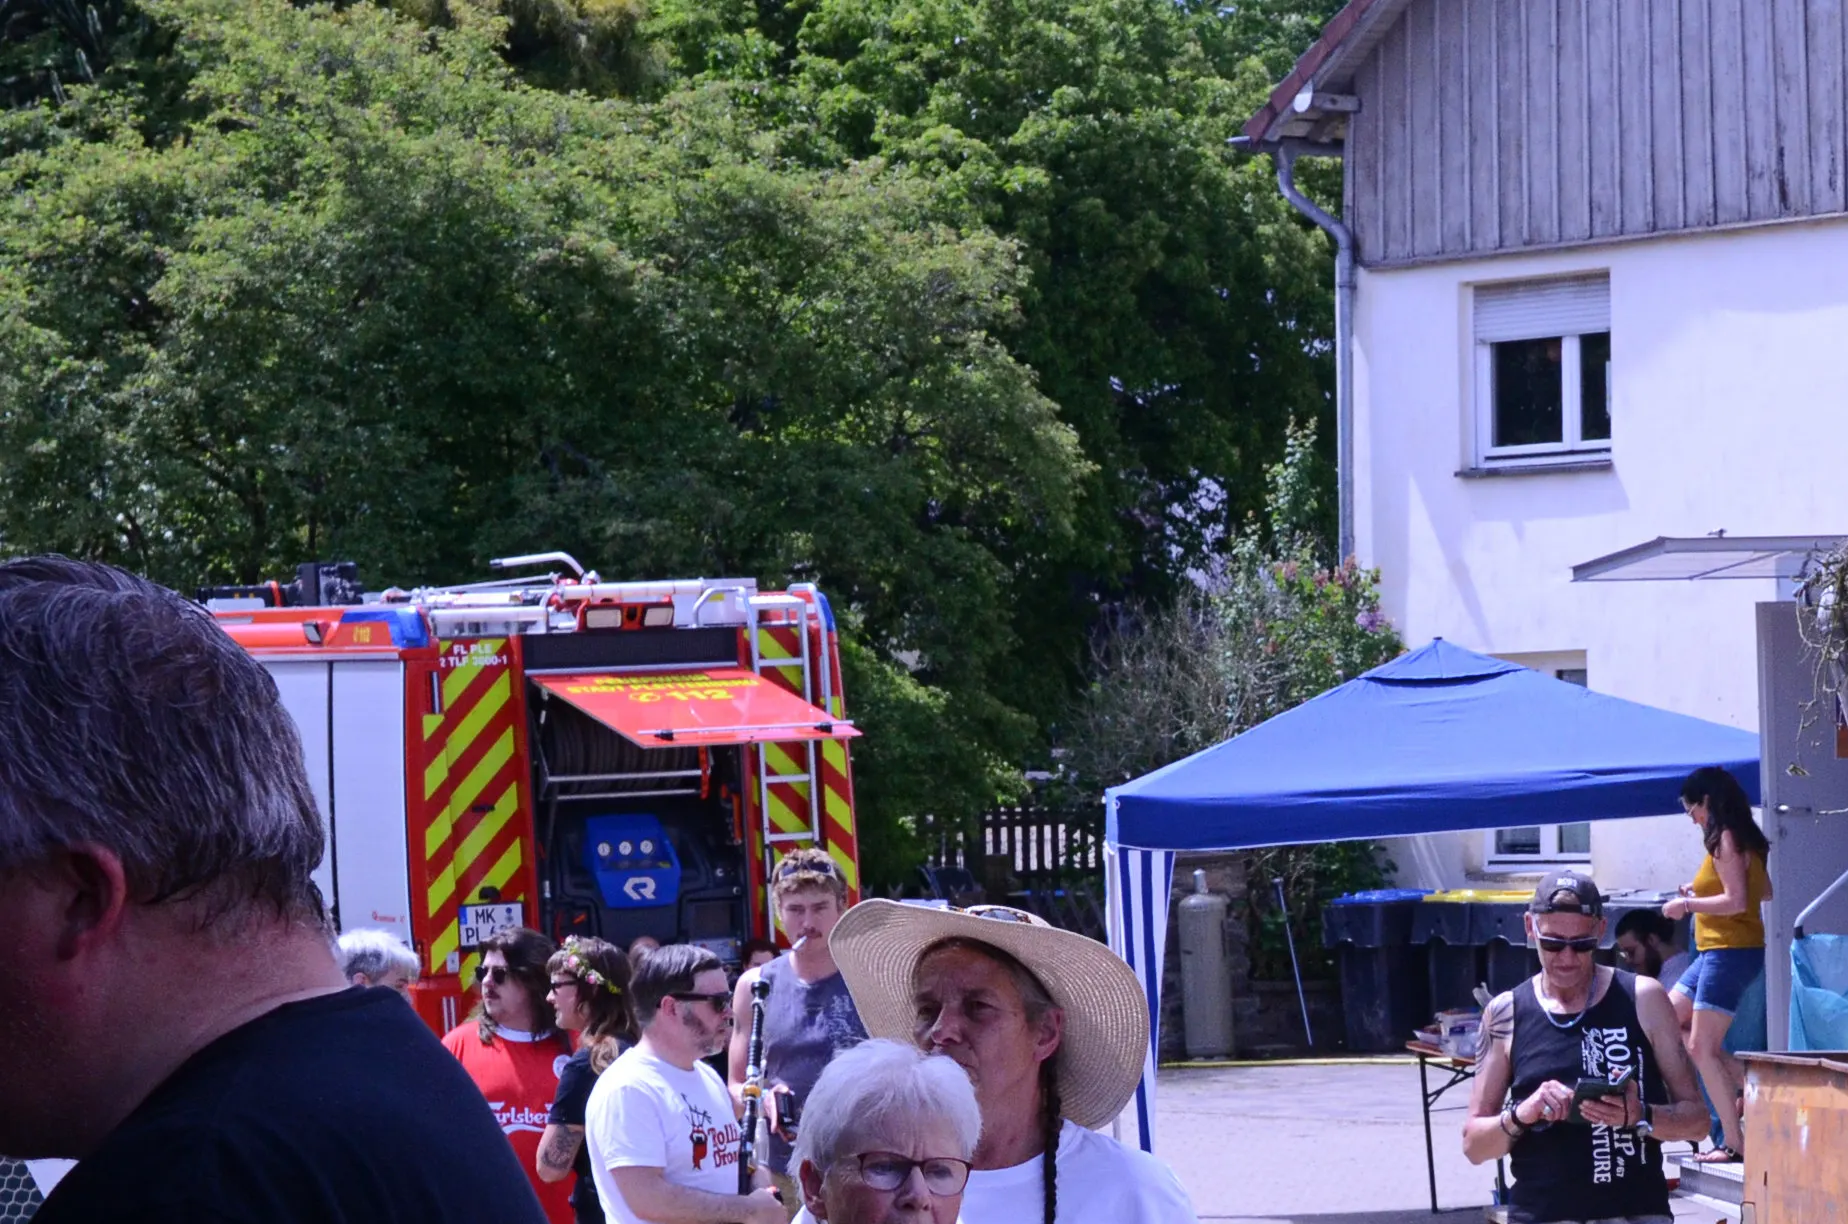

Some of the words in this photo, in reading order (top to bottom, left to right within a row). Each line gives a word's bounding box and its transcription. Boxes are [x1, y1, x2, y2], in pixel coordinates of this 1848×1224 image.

[453, 644, 468, 655] FL
[470, 643, 493, 654] PLE
[448, 656, 469, 667] TLF
[665, 688, 734, 701] 112
[475, 907, 496, 925] MK
[1591, 1120, 1611, 1184] NTURE
